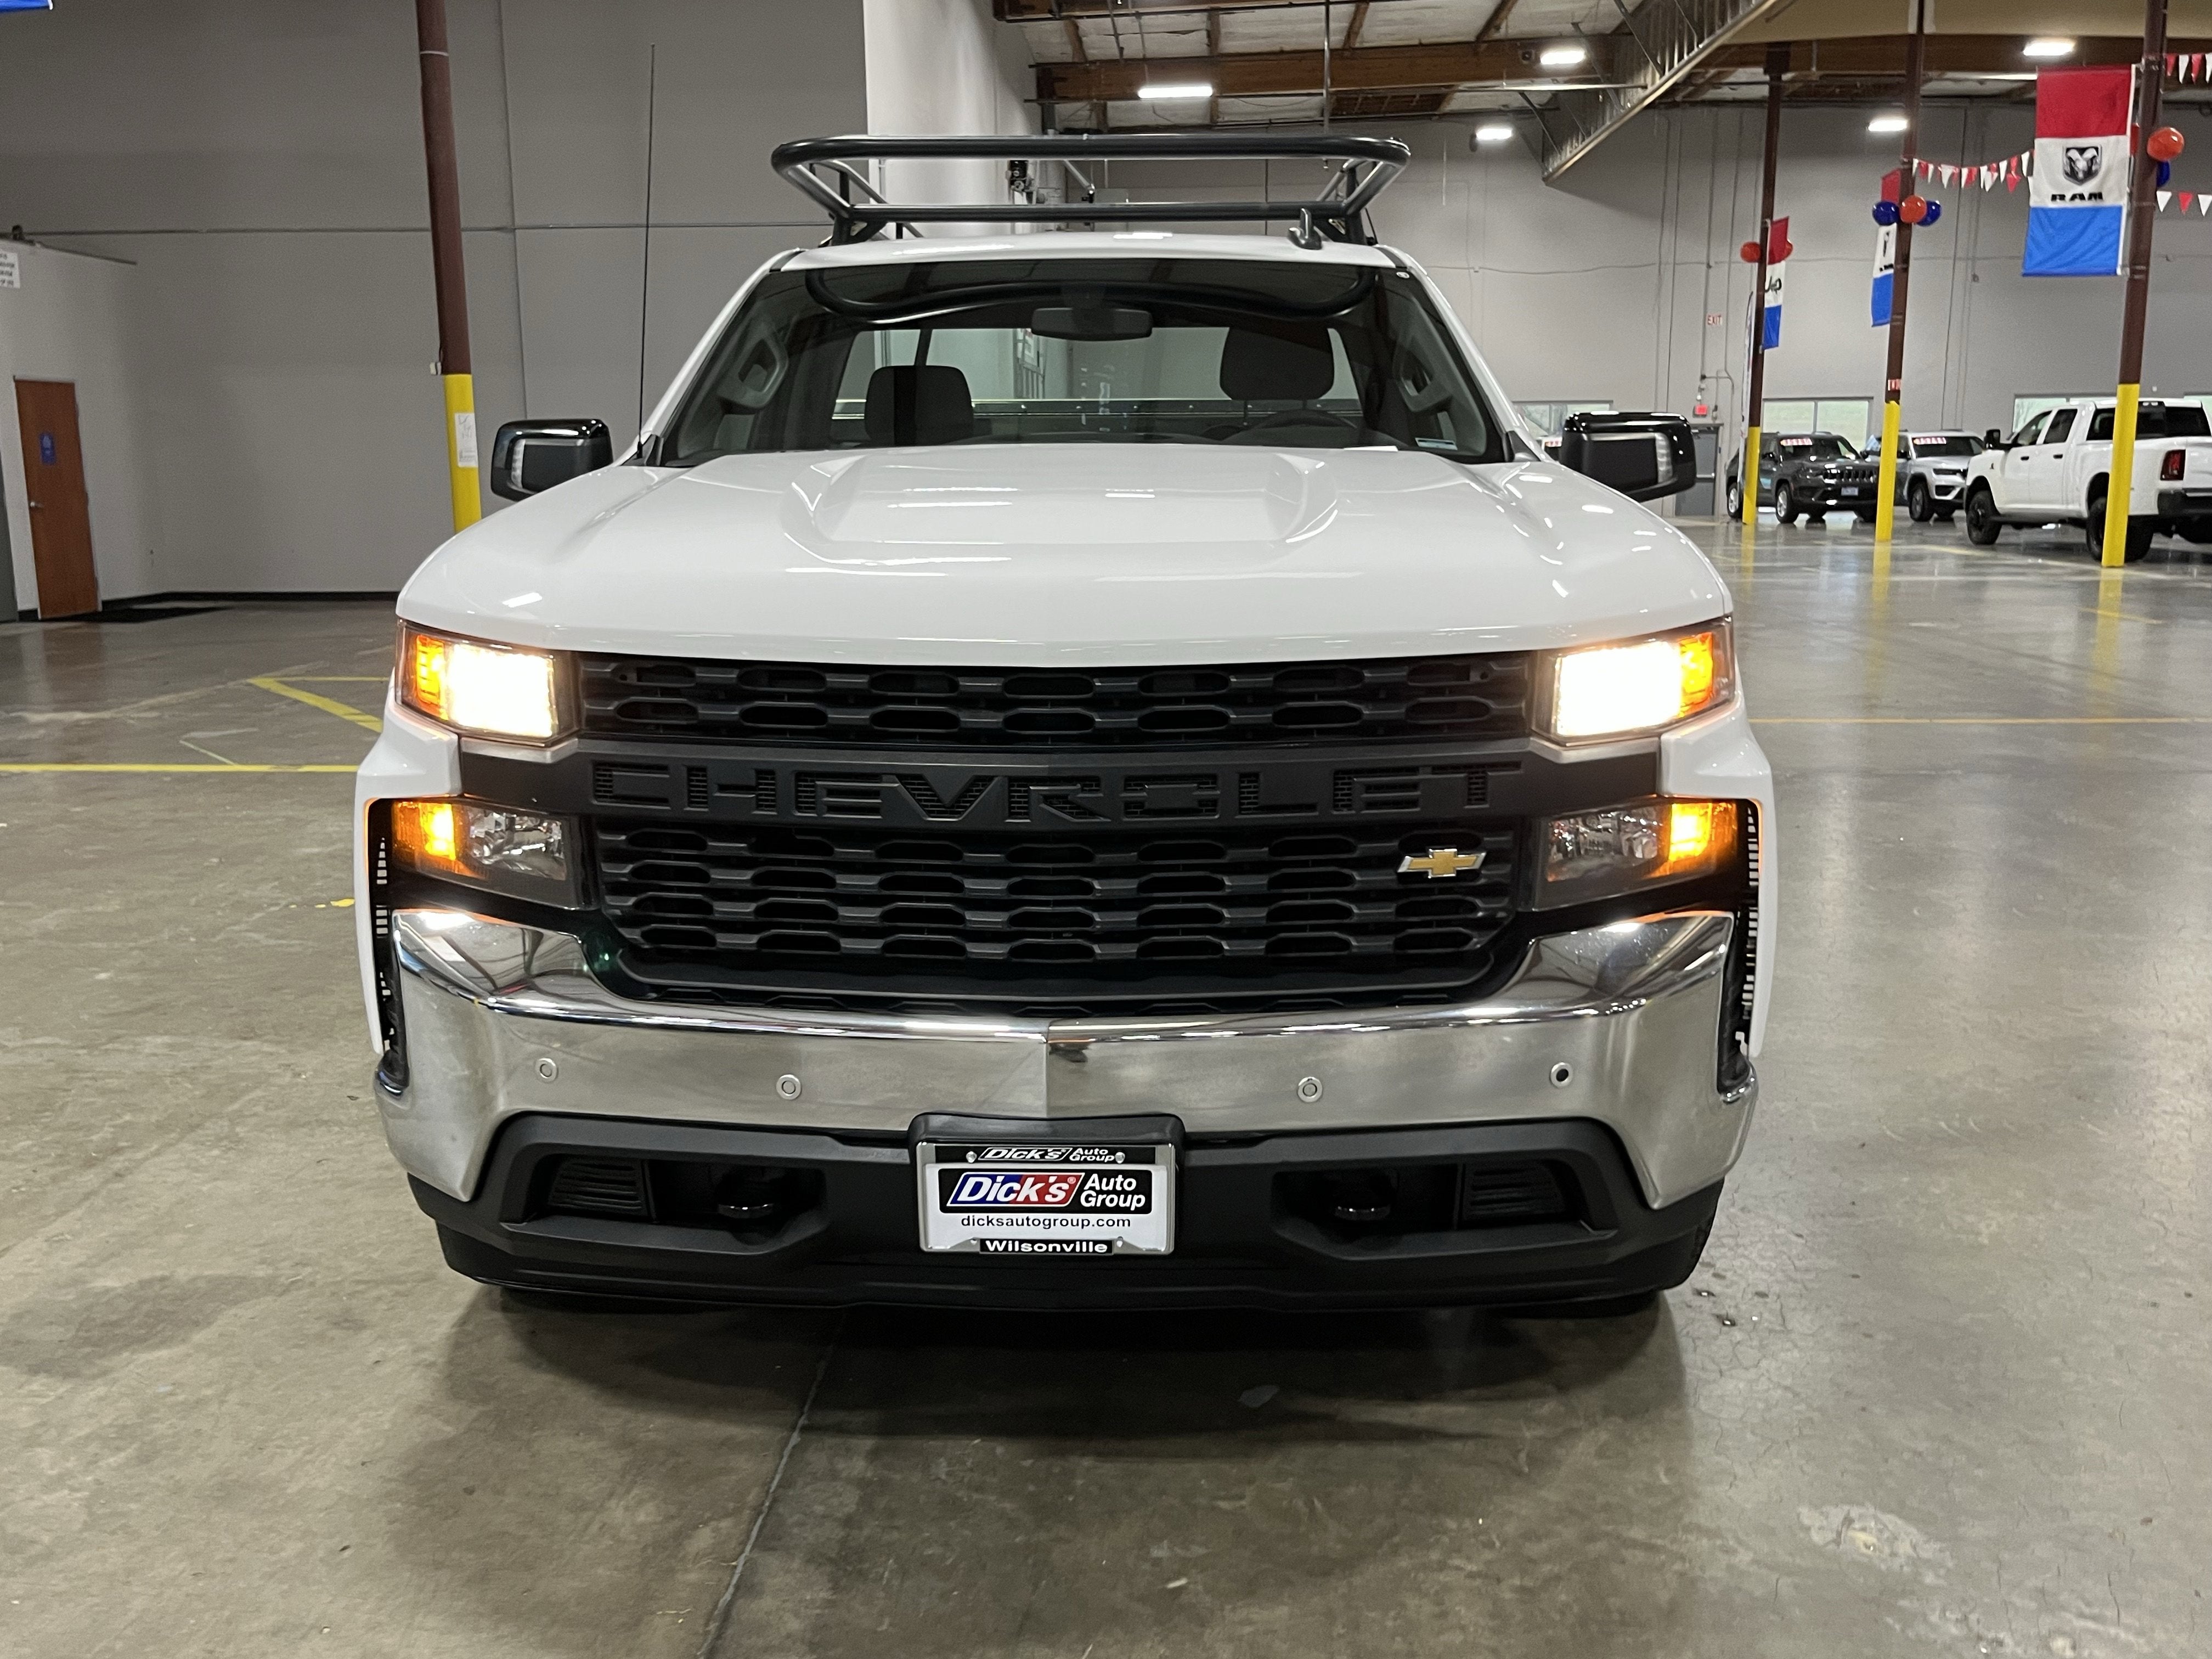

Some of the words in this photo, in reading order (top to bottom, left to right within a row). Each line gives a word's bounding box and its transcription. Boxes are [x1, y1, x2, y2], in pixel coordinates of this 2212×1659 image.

[2051, 192, 2103, 201] RAM
[591, 760, 1523, 822] CHEVROLET
[984, 1148, 1062, 1160] Dick's
[1070, 1154, 1115, 1163] Group
[1084, 1173, 1137, 1190] Auto
[957, 1176, 1069, 1202] Dick's
[1080, 1190, 1146, 1211] Group
[961, 1215, 1131, 1229] dicksautogroup.com
[985, 1240, 1108, 1253] Wilsonville
